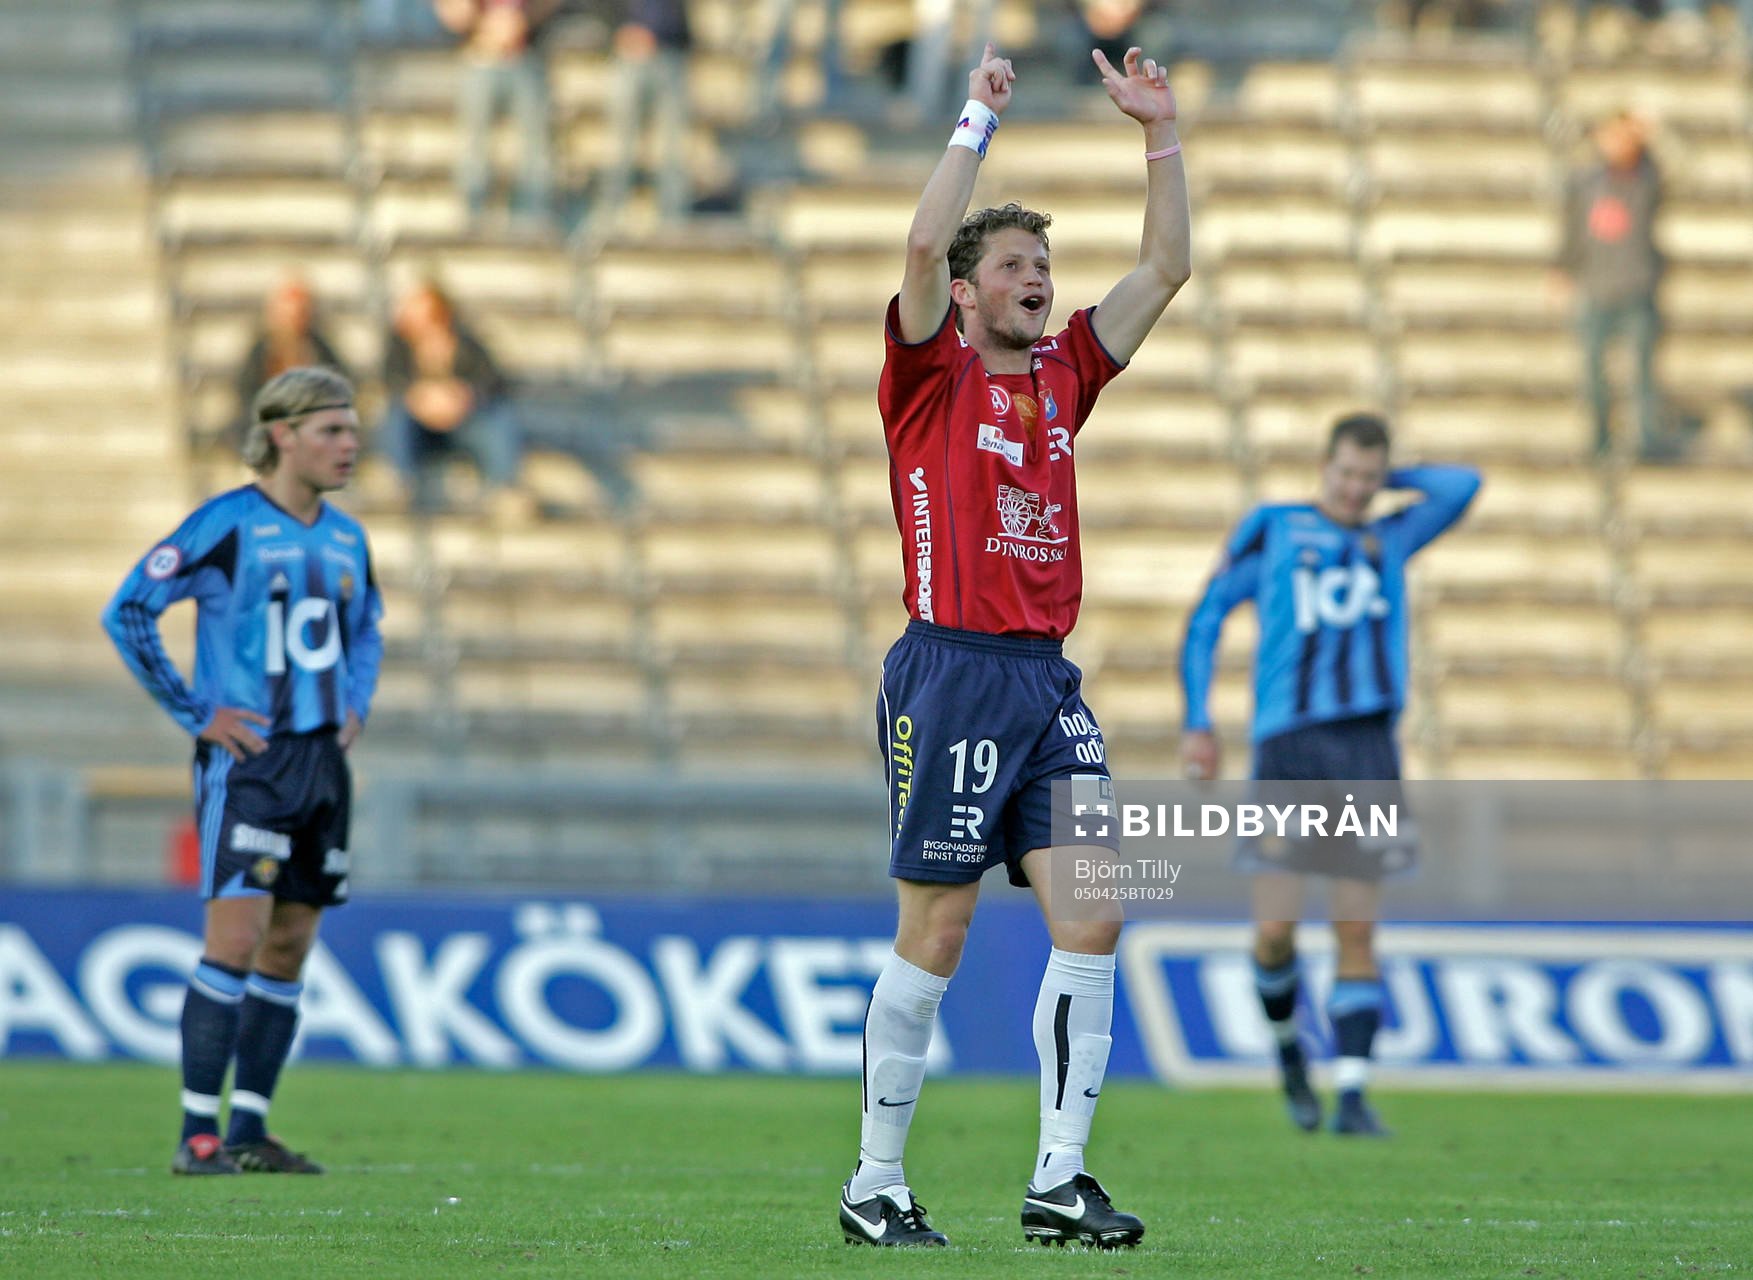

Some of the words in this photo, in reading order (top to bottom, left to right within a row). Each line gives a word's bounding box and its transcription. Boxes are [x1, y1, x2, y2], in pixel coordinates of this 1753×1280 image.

[912, 493, 934, 623] INTERSPORT
[949, 738, 998, 794] 19
[950, 805, 984, 840] ER
[922, 850, 953, 861] ERNST
[923, 840, 988, 853] BYGGNADSFIR
